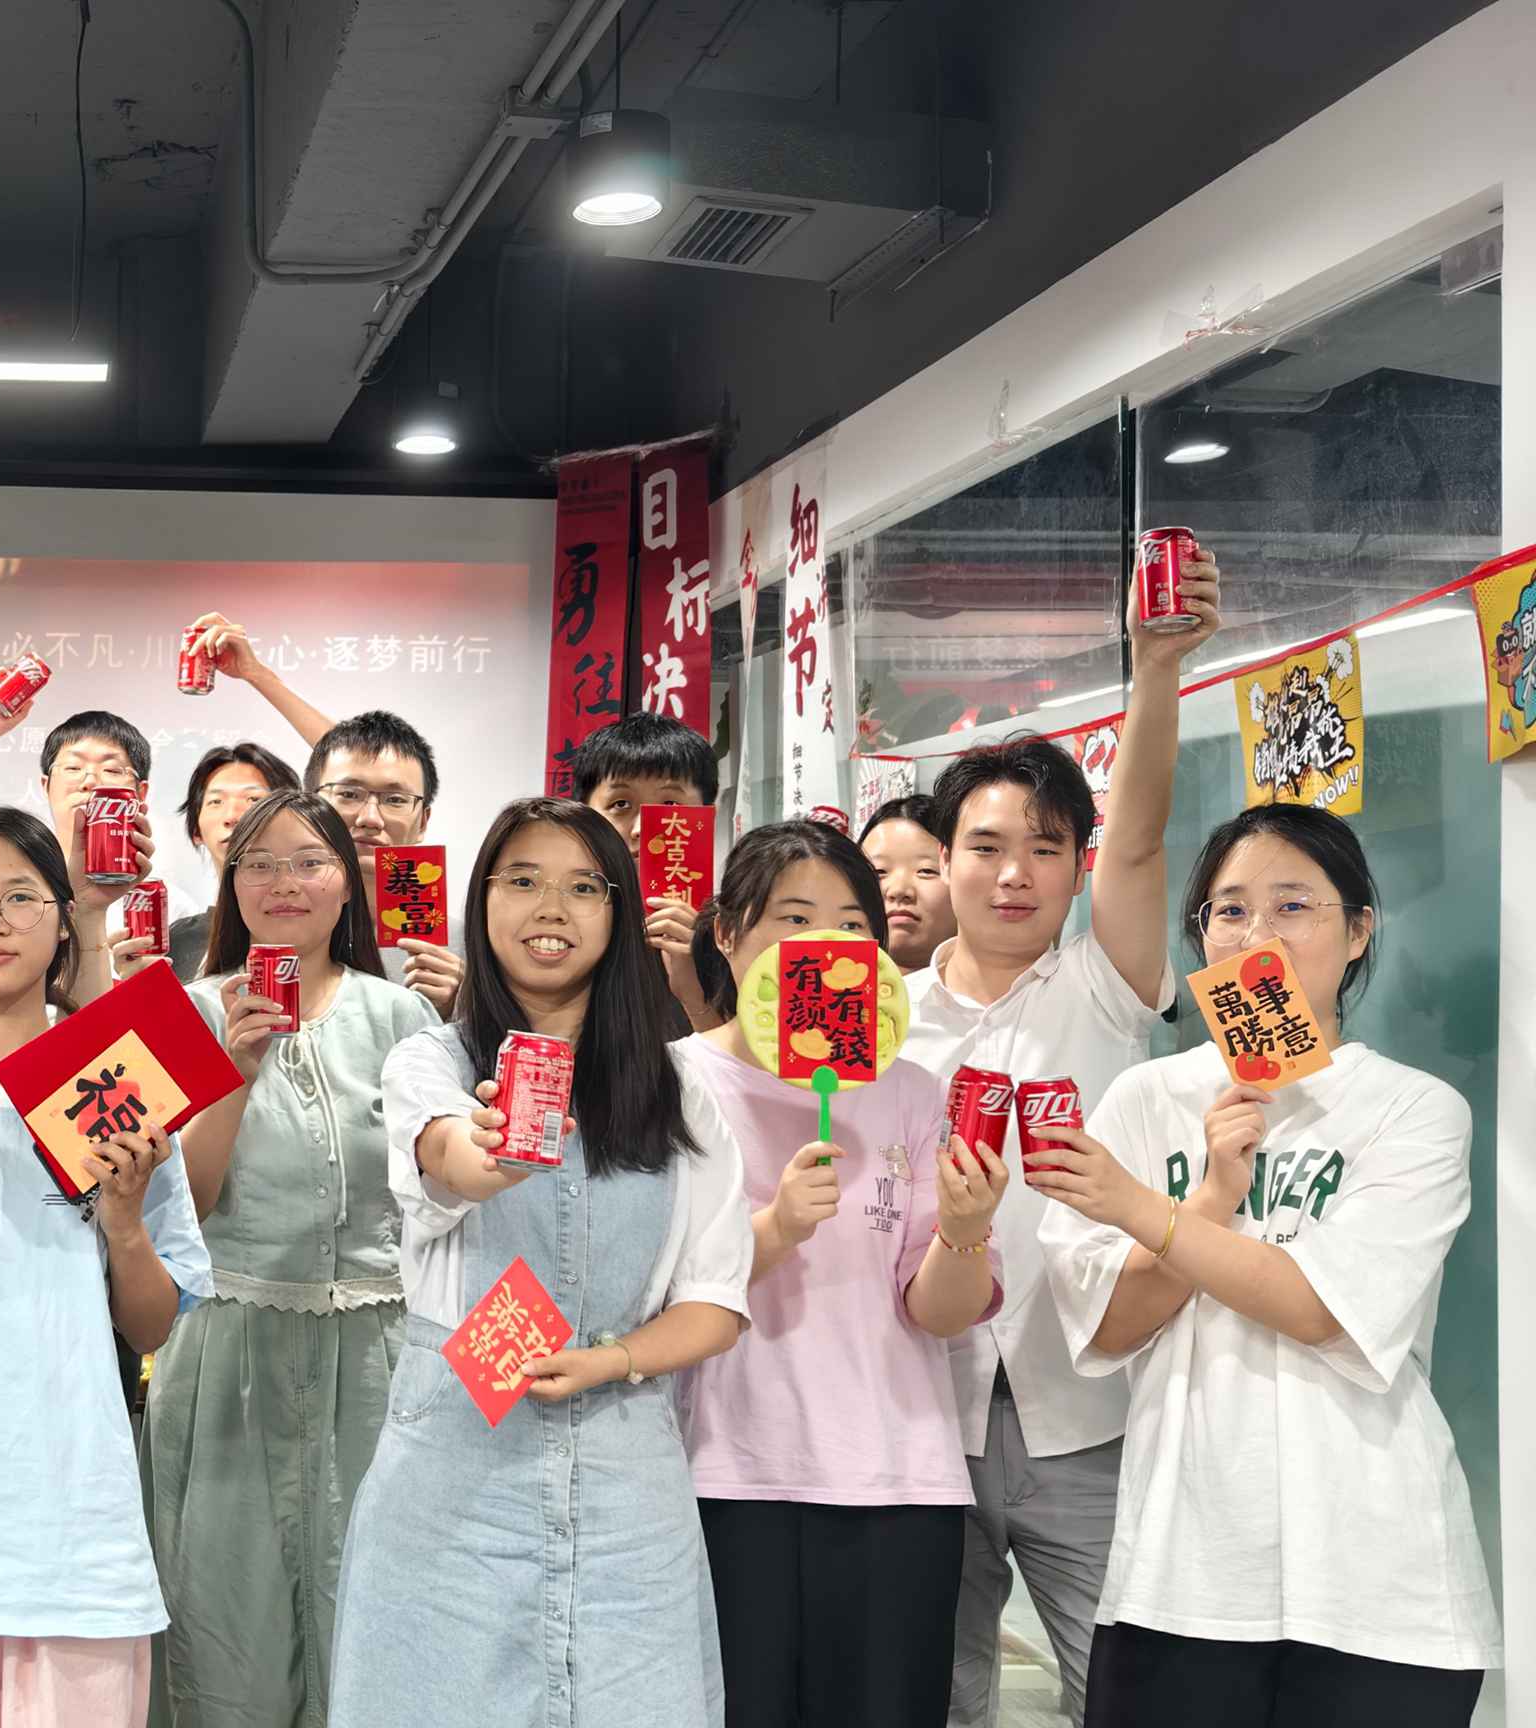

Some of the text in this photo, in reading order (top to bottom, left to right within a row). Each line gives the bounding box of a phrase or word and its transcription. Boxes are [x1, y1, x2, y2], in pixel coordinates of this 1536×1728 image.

[660, 811, 697, 906] 大吉大利
[384, 859, 435, 935] 暴富
[875, 1176, 895, 1208] YOU
[1166, 1149, 1346, 1223] RNGER
